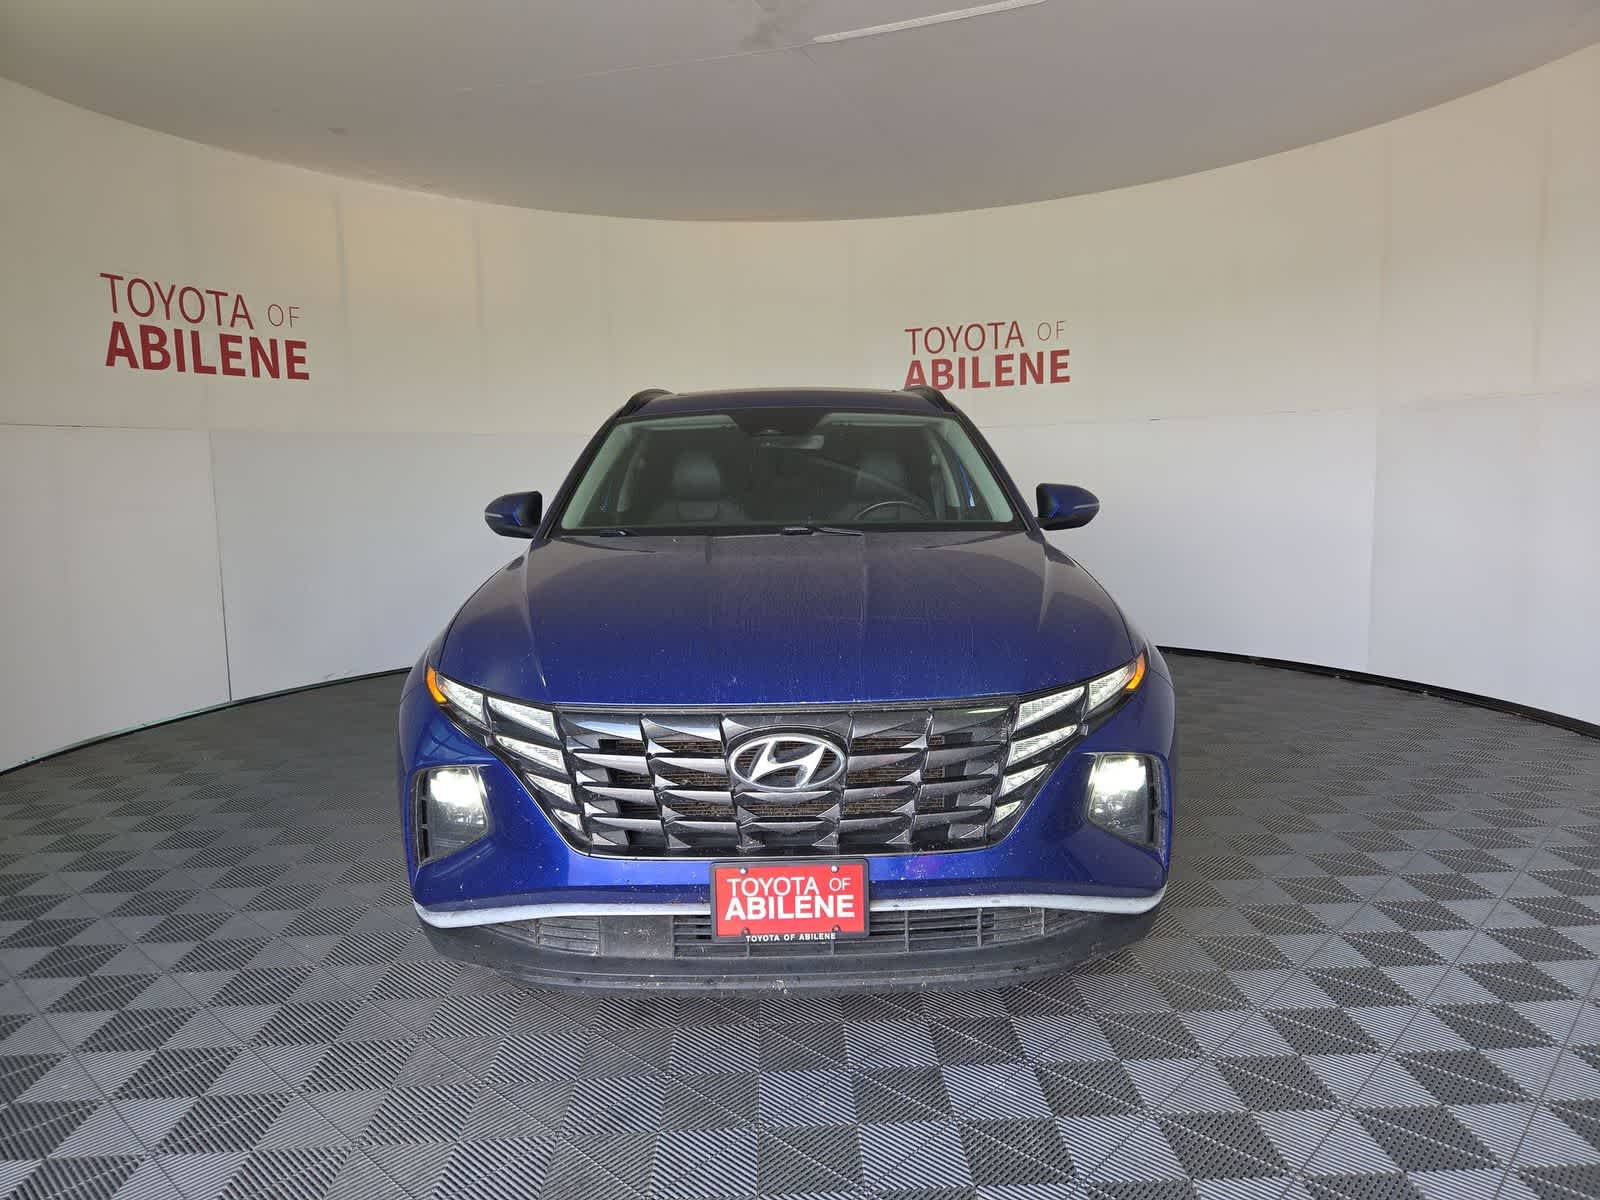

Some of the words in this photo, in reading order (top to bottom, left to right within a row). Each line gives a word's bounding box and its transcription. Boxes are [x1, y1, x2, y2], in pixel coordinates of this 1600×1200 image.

[100, 273, 254, 329] TOYOTA
[267, 303, 300, 328] OF
[105, 321, 310, 380] ABILENE
[904, 320, 1025, 355] TOYOTA
[1037, 320, 1065, 342] OF
[904, 349, 1071, 391] ABILENE
[726, 876, 820, 897] TOYOTA
[828, 877, 851, 892] OF
[725, 894, 856, 920] ABILENE
[746, 934, 780, 942] TOYOTA
[799, 932, 836, 941] ABILENE
